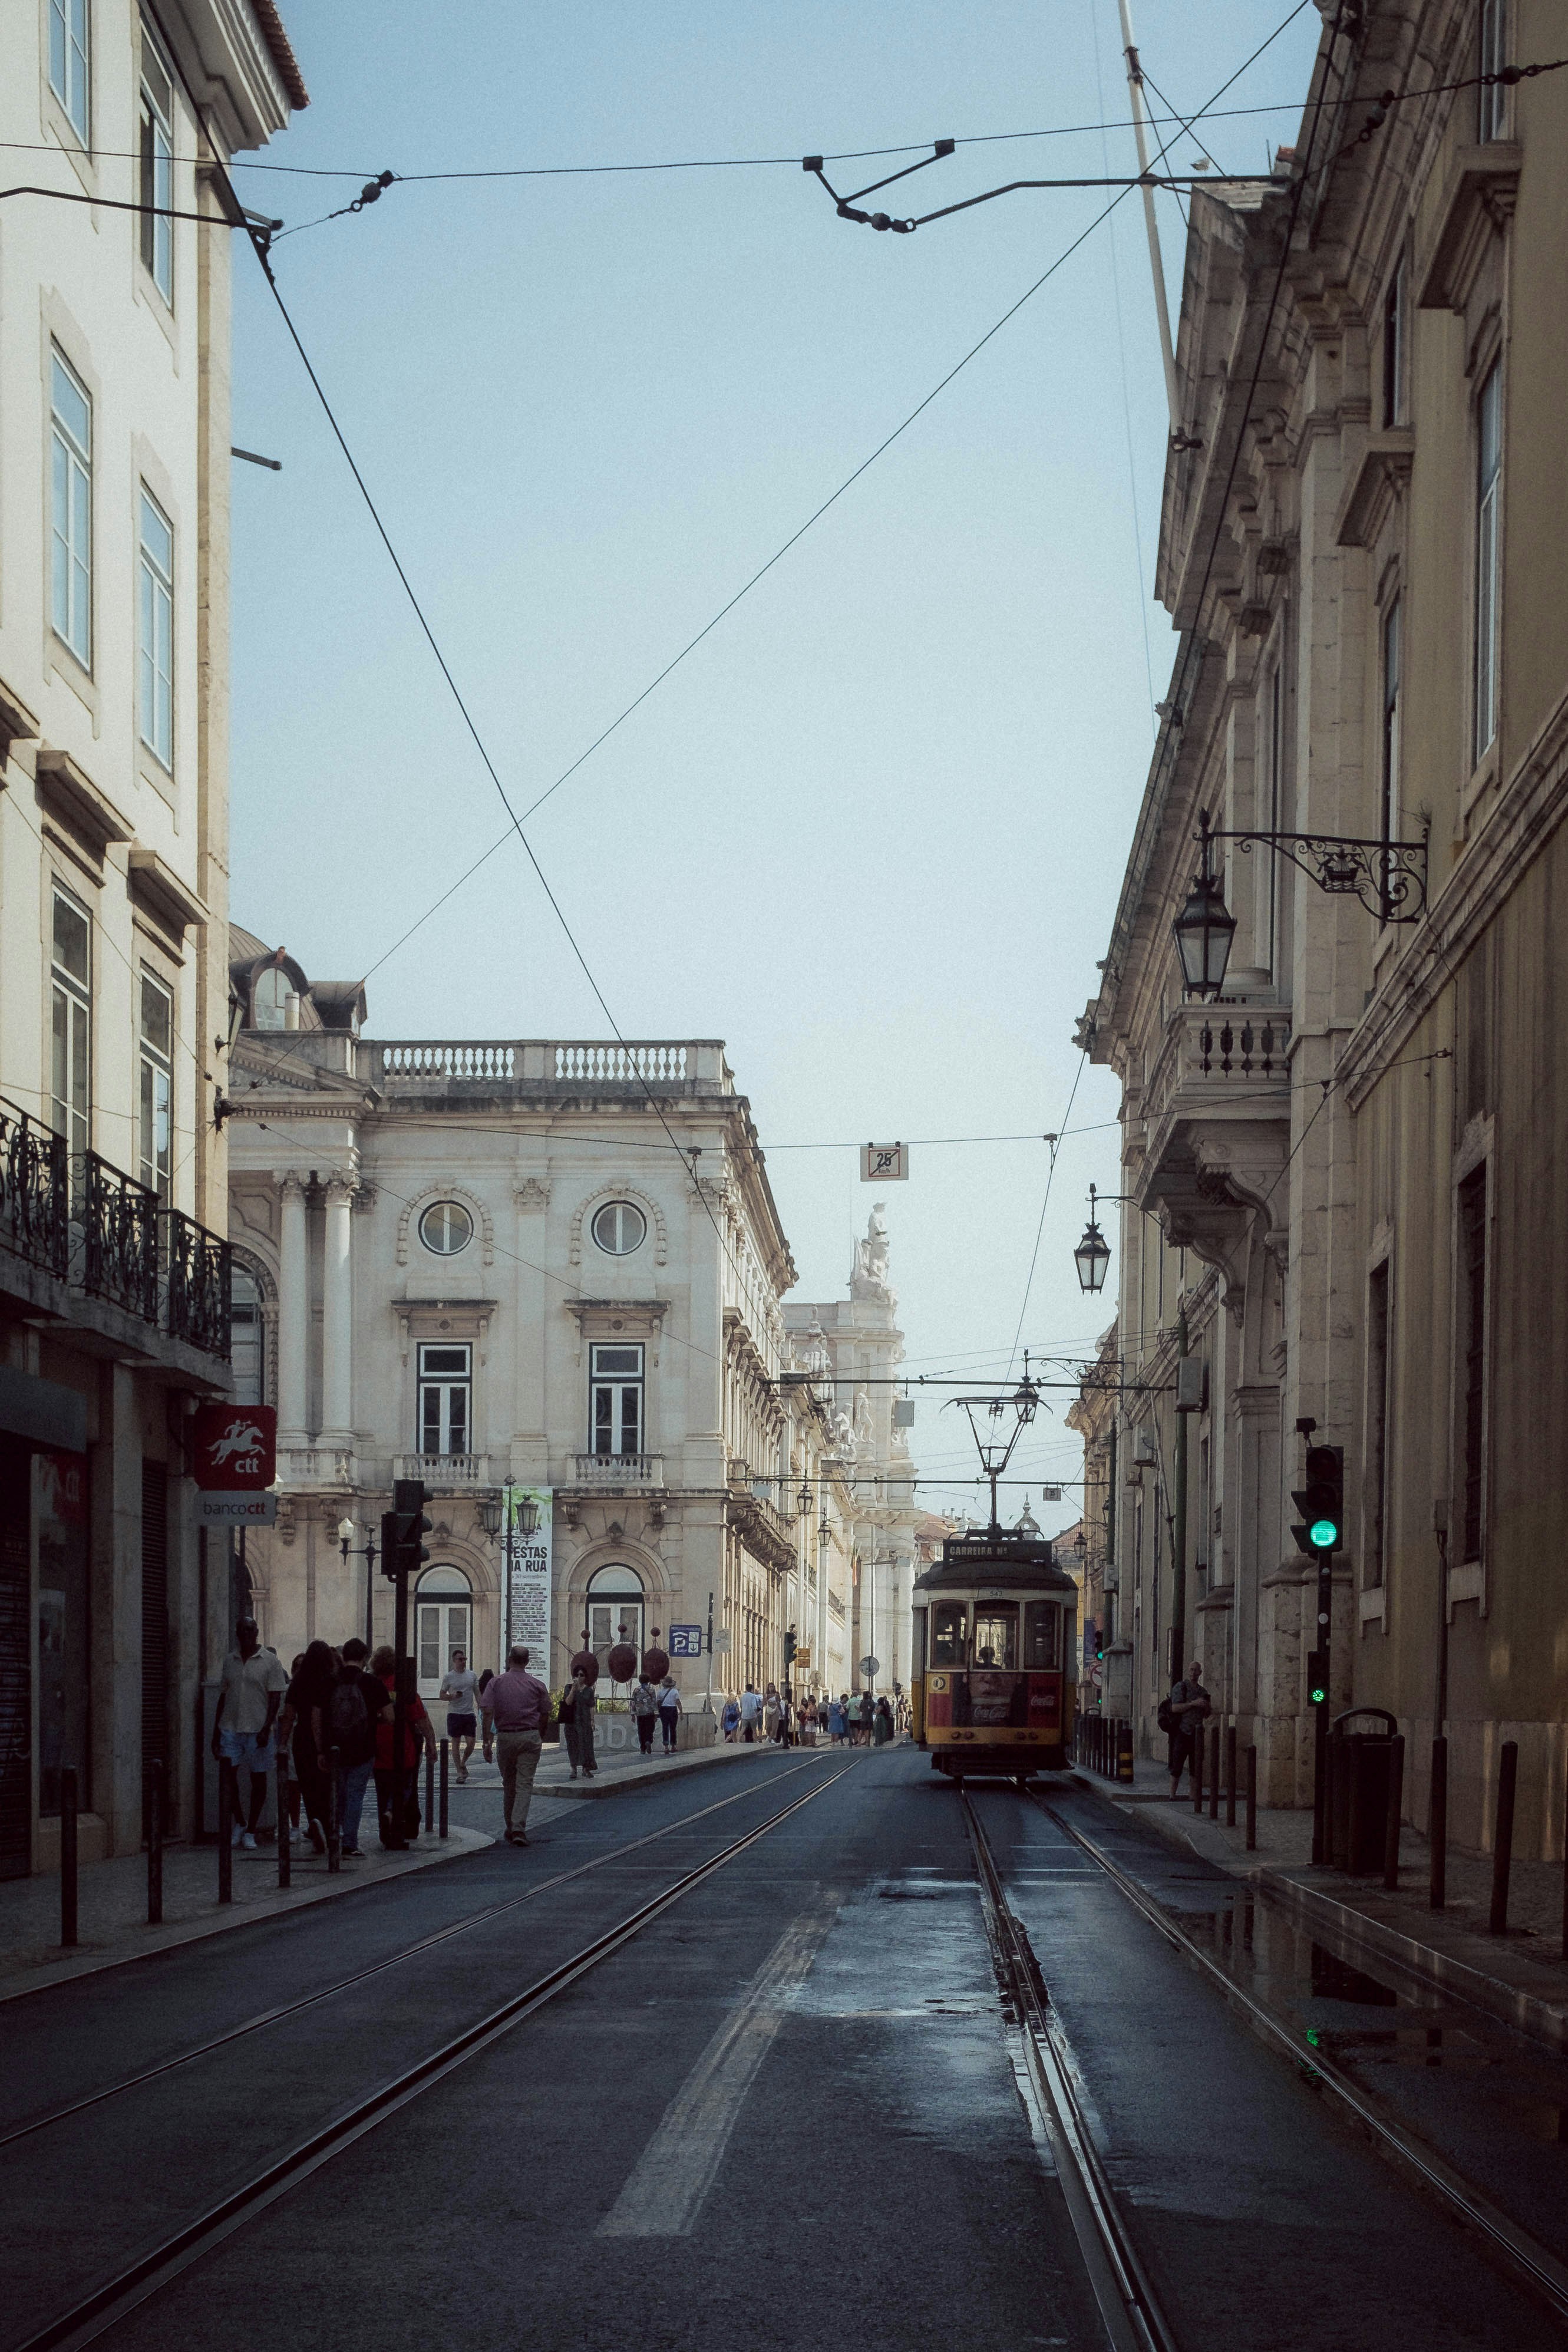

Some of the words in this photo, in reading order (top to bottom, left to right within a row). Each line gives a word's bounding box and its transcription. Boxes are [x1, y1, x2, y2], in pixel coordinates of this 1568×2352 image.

[235, 1458, 259, 1472] ctt
[513, 1546, 547, 1558] ESTAS
[950, 1546, 992, 1556] CARREIRA
[526, 1560, 547, 1572] RUA
